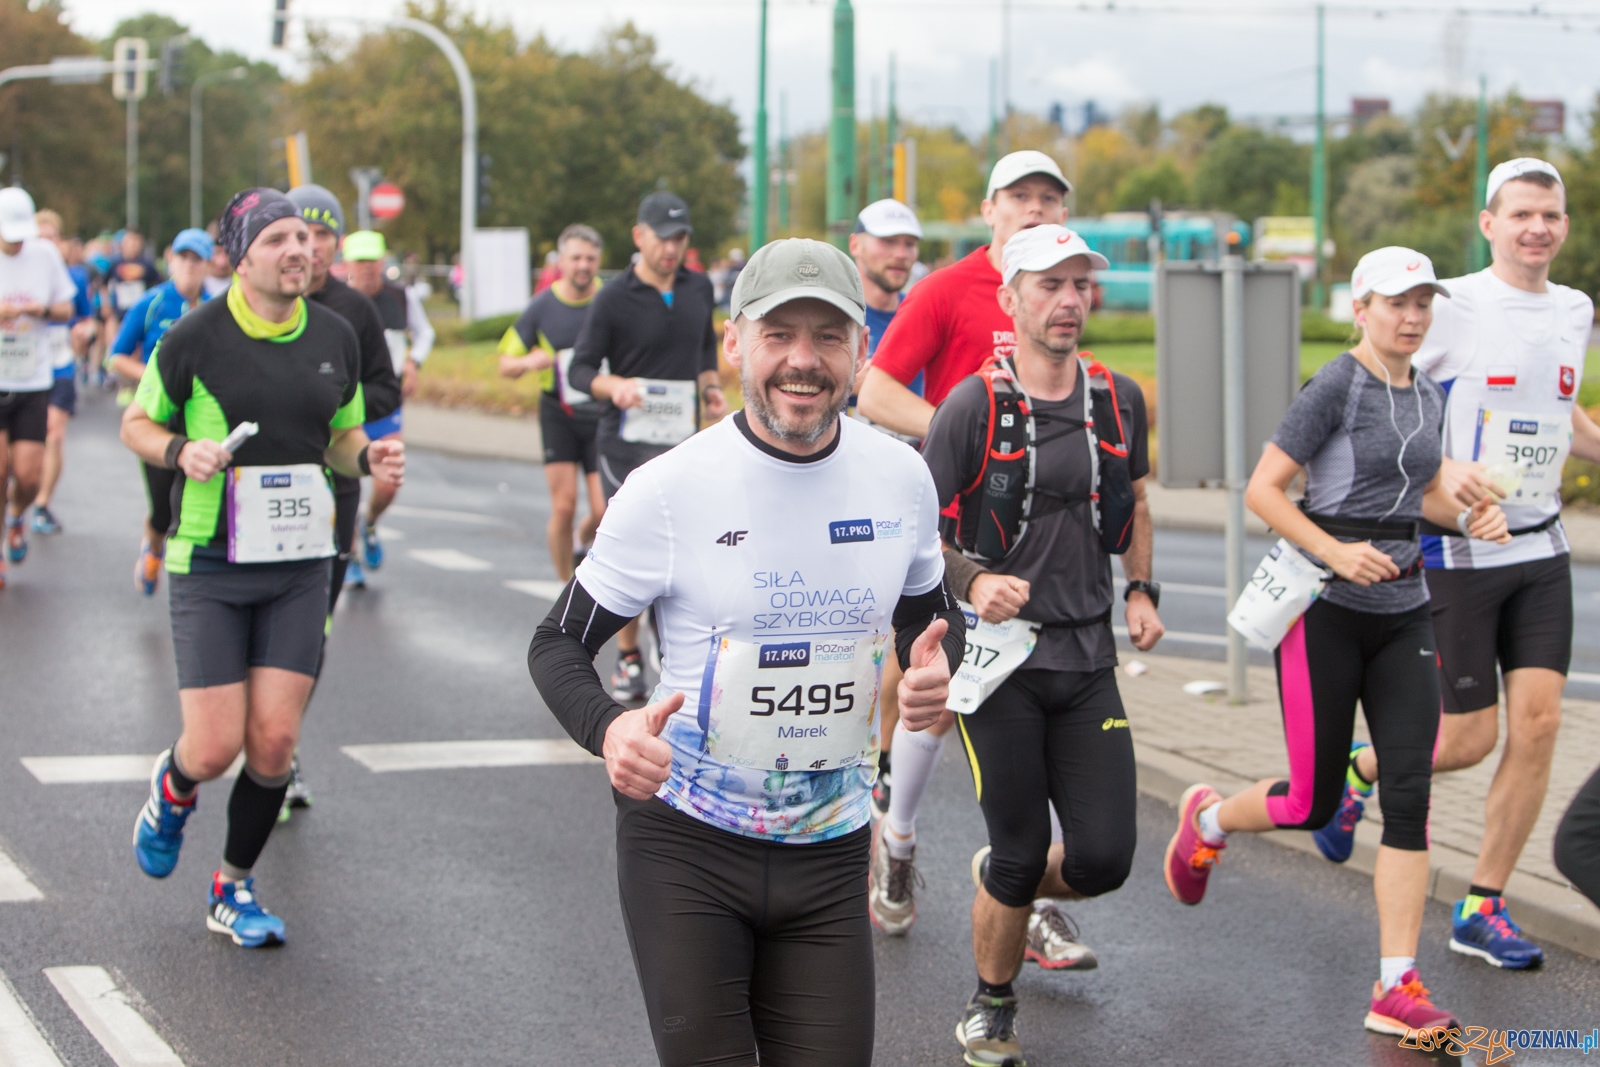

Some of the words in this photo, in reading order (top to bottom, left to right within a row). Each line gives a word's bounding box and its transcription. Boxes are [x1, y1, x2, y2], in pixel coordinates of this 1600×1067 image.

[798, 264, 819, 275] nike
[1506, 444, 1558, 465] 3907
[268, 497, 311, 519] 335
[716, 530, 749, 546] 4F
[877, 528, 903, 536] maraton
[754, 570, 805, 588] SIŁA
[770, 588, 876, 609] ODWAGA
[753, 606, 875, 630] SZYBKOŚĆ
[814, 652, 855, 661] maraton
[750, 681, 855, 717] 5495
[778, 725, 828, 739] Marek
[809, 759, 828, 769] 4F
